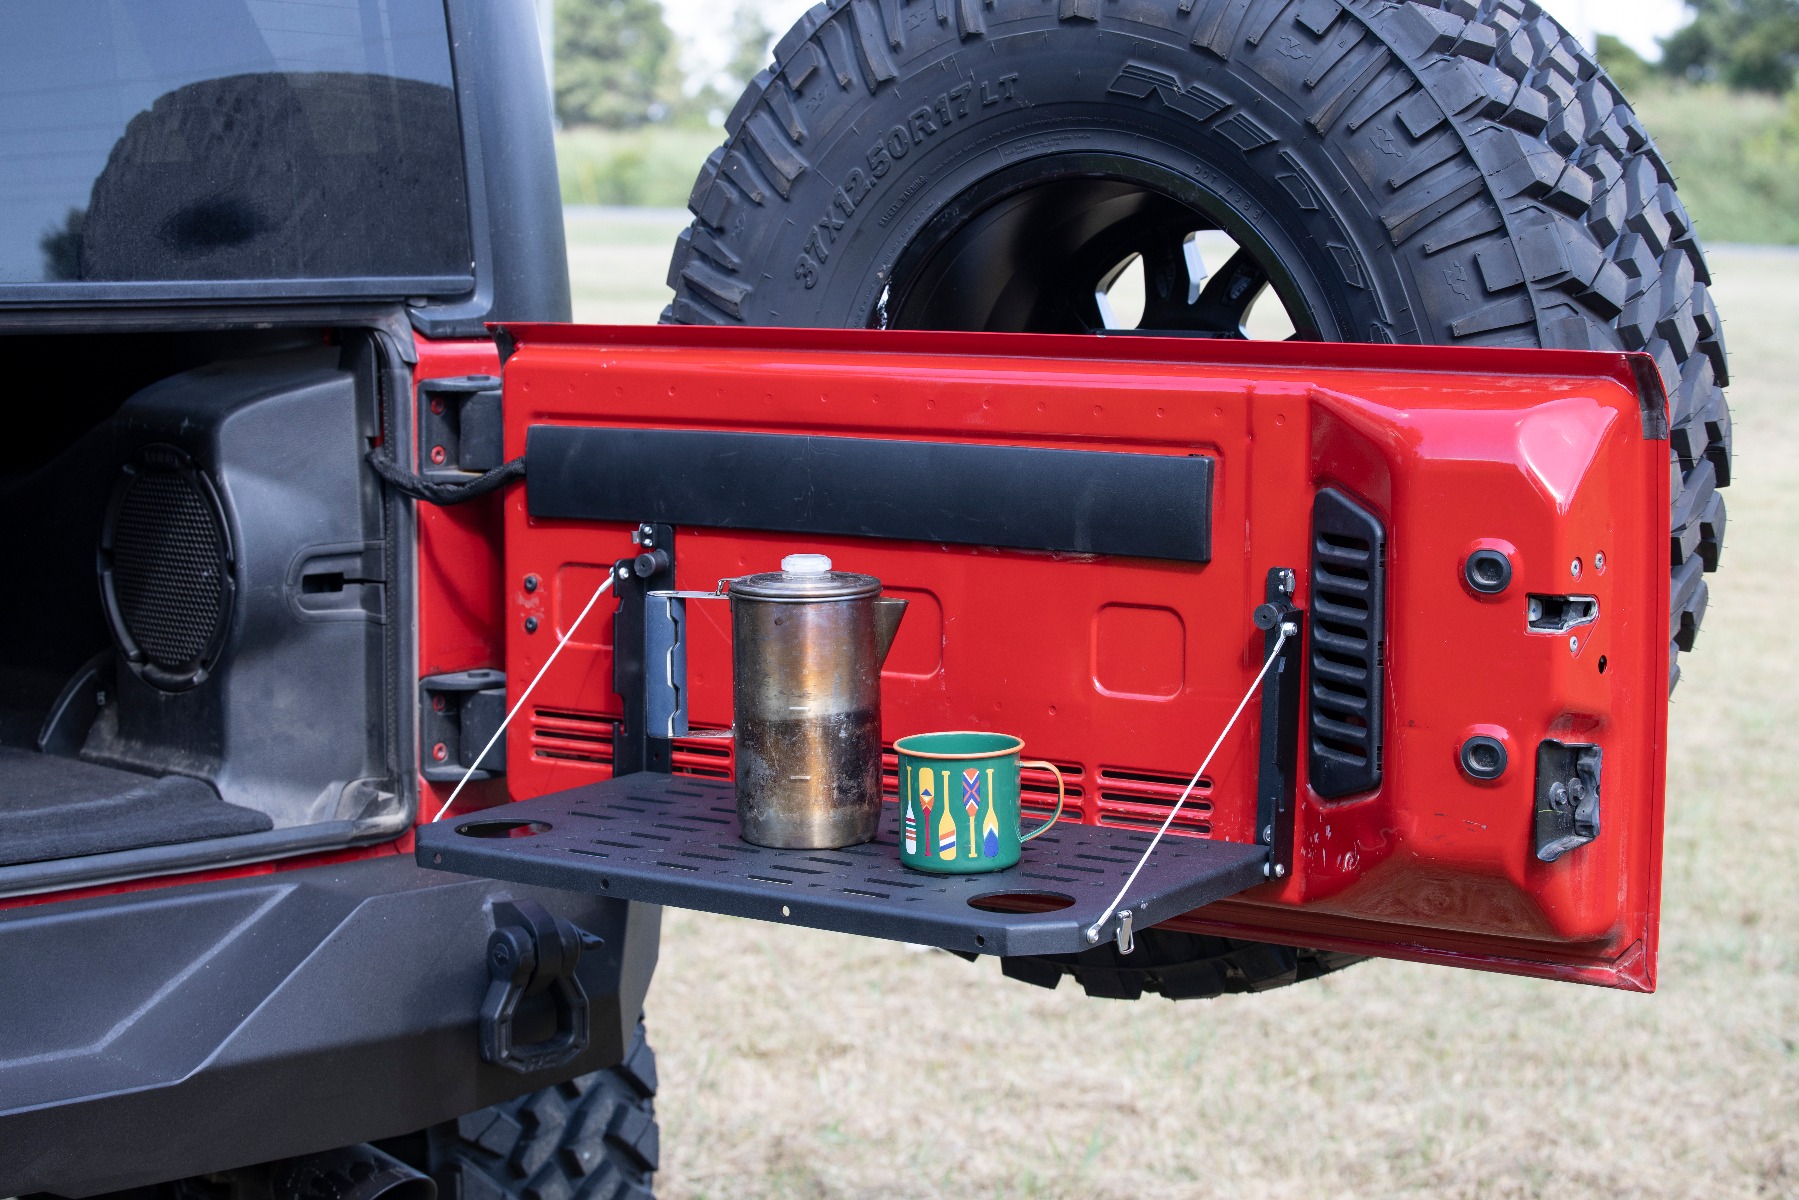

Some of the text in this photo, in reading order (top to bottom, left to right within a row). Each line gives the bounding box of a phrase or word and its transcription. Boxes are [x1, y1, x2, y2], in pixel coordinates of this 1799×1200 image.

[795, 80, 972, 289] 37X12.50R17
[979, 72, 1018, 108] LT
[1194, 164, 1217, 182] DOT
[878, 202, 899, 227] SAFETY
